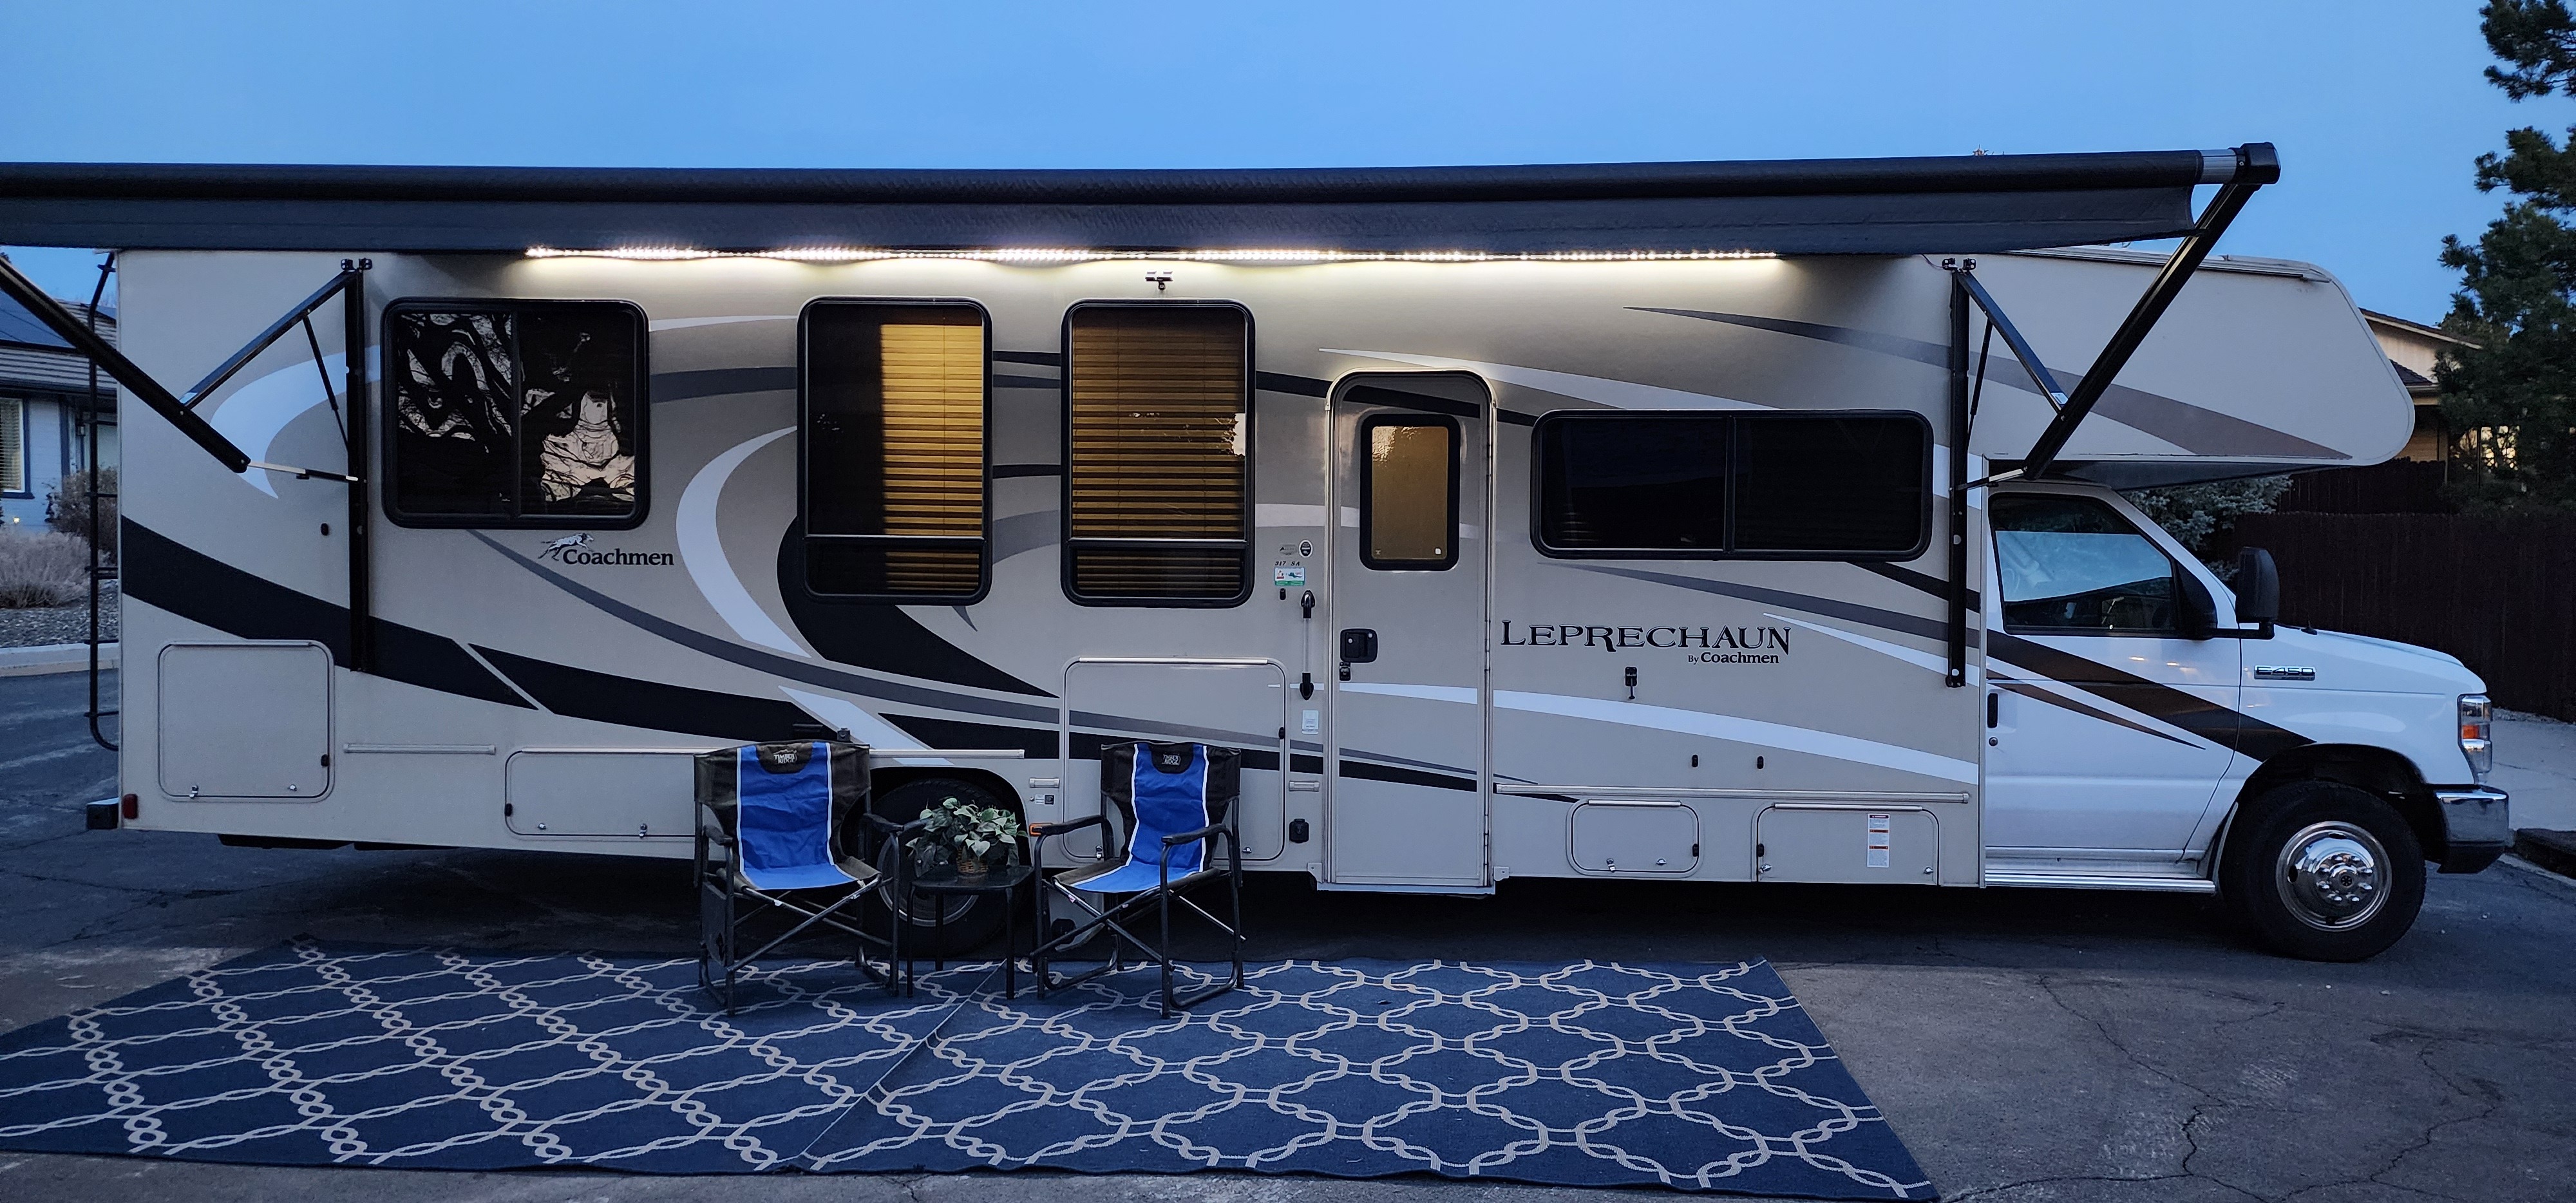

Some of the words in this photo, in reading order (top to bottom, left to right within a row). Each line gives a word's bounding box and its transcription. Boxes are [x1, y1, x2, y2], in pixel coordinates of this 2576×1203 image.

[563, 548, 674, 565] Coachmen
[1500, 620, 1792, 655] LEPRECHAUN
[1688, 654, 1699, 665] By
[1700, 652, 1780, 664] Coachmen
